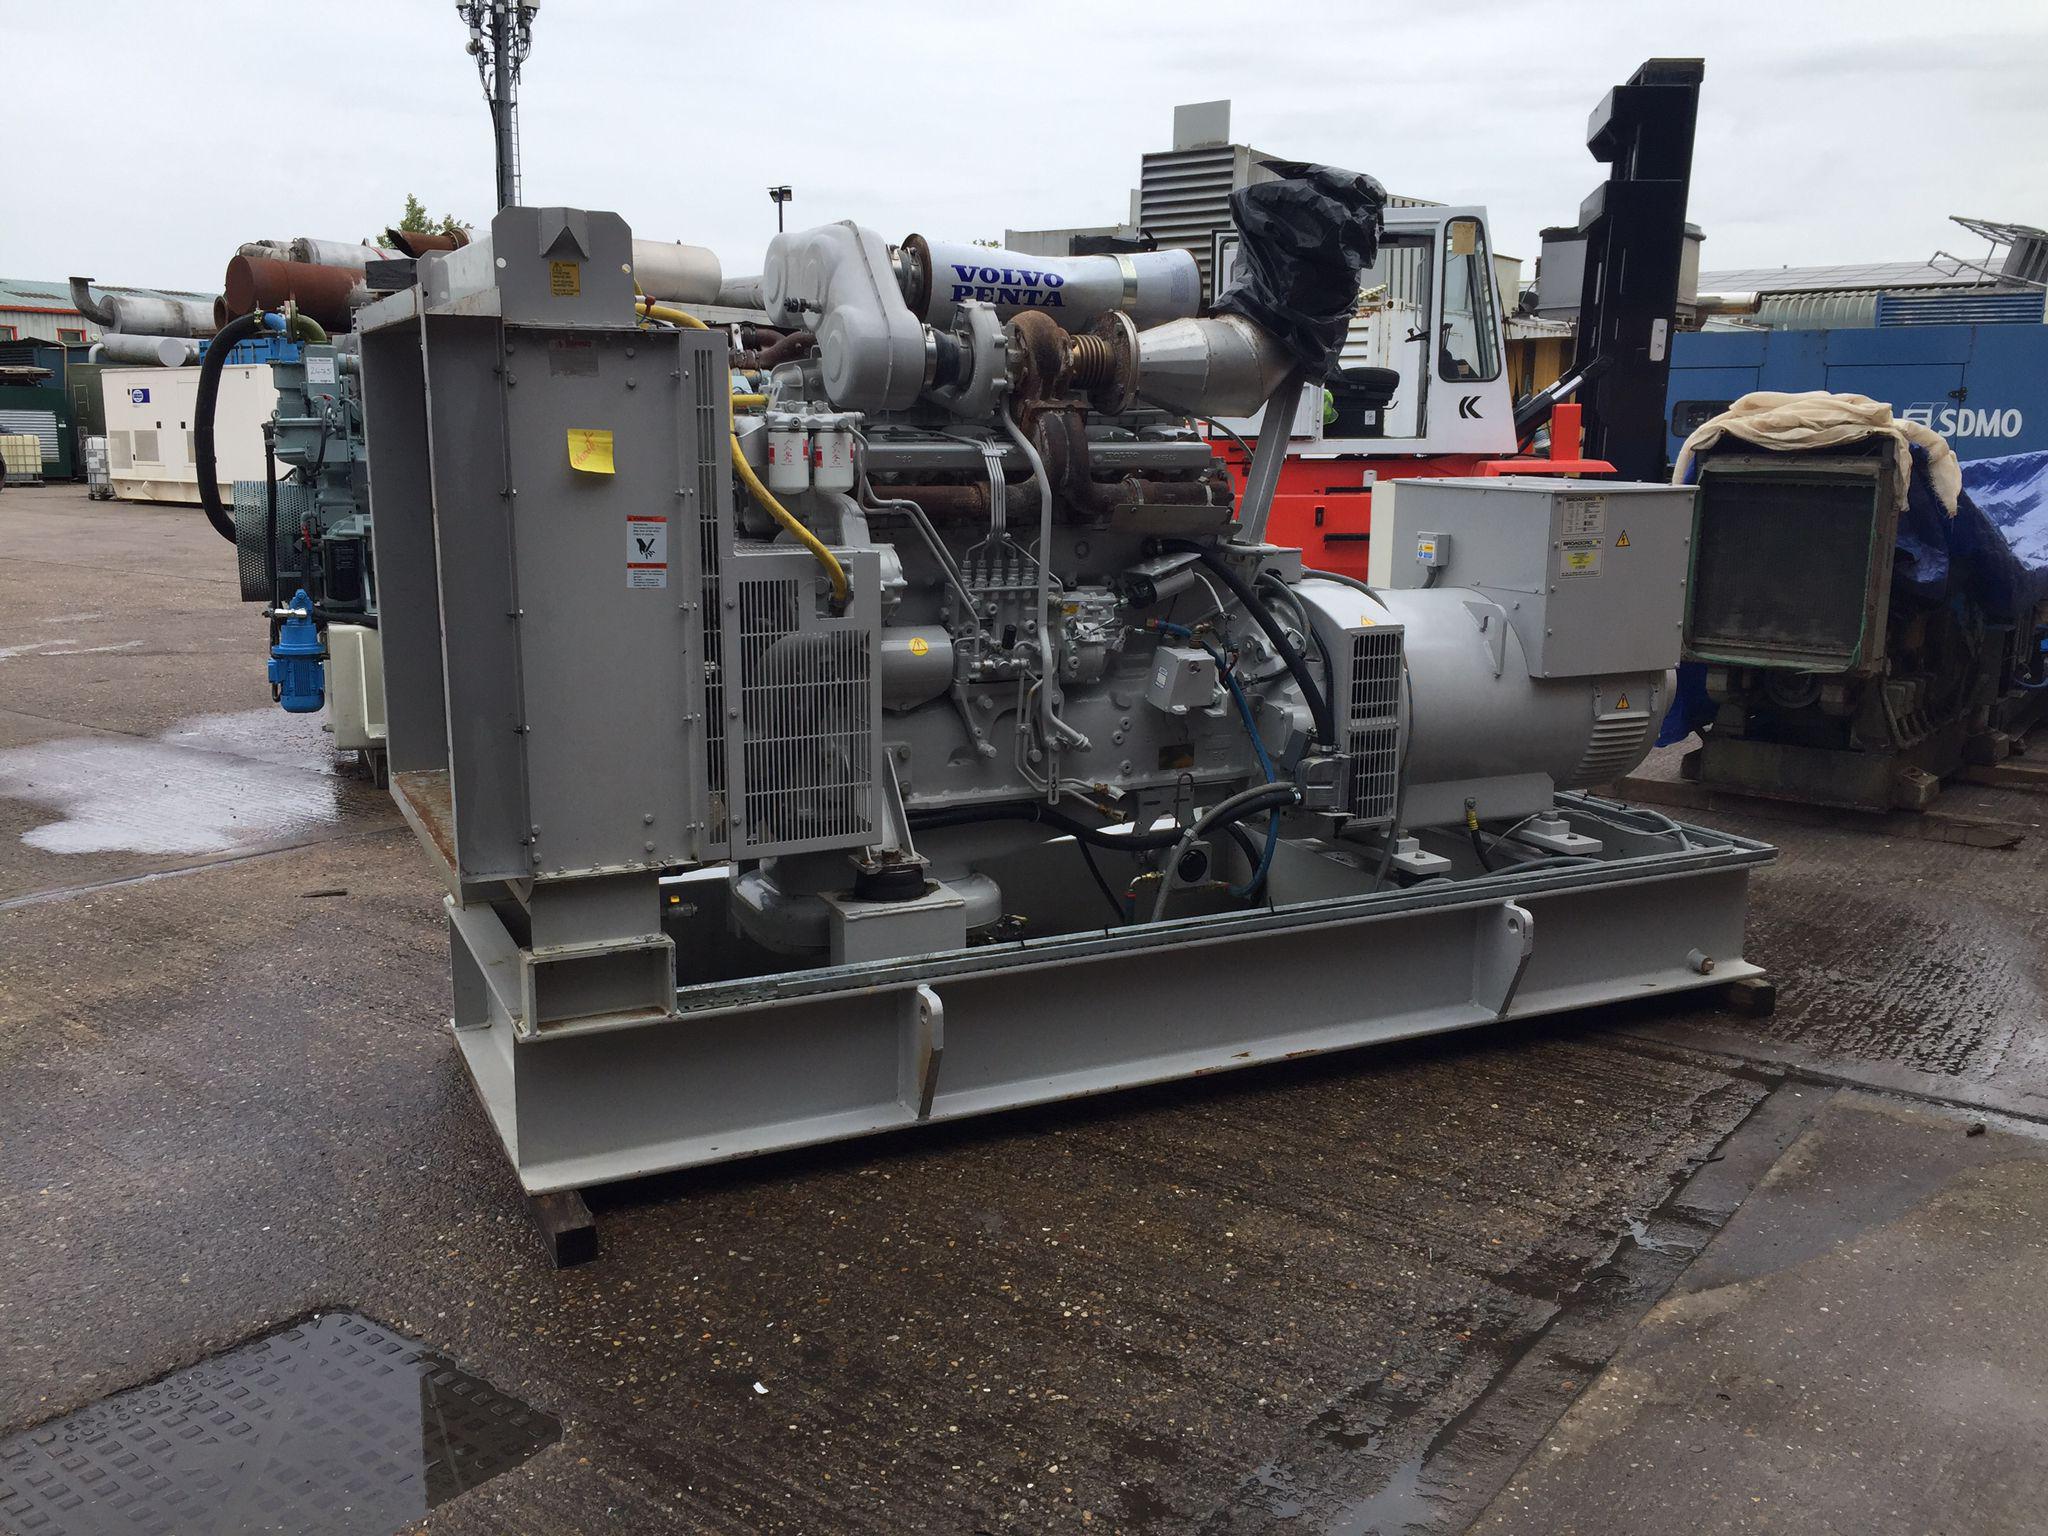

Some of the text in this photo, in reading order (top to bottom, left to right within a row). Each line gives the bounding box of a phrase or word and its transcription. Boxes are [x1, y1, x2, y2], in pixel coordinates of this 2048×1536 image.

[951, 264, 1065, 288] VOLVO
[950, 284, 1066, 307] PENTA
[1938, 408, 2023, 438] SDMO
